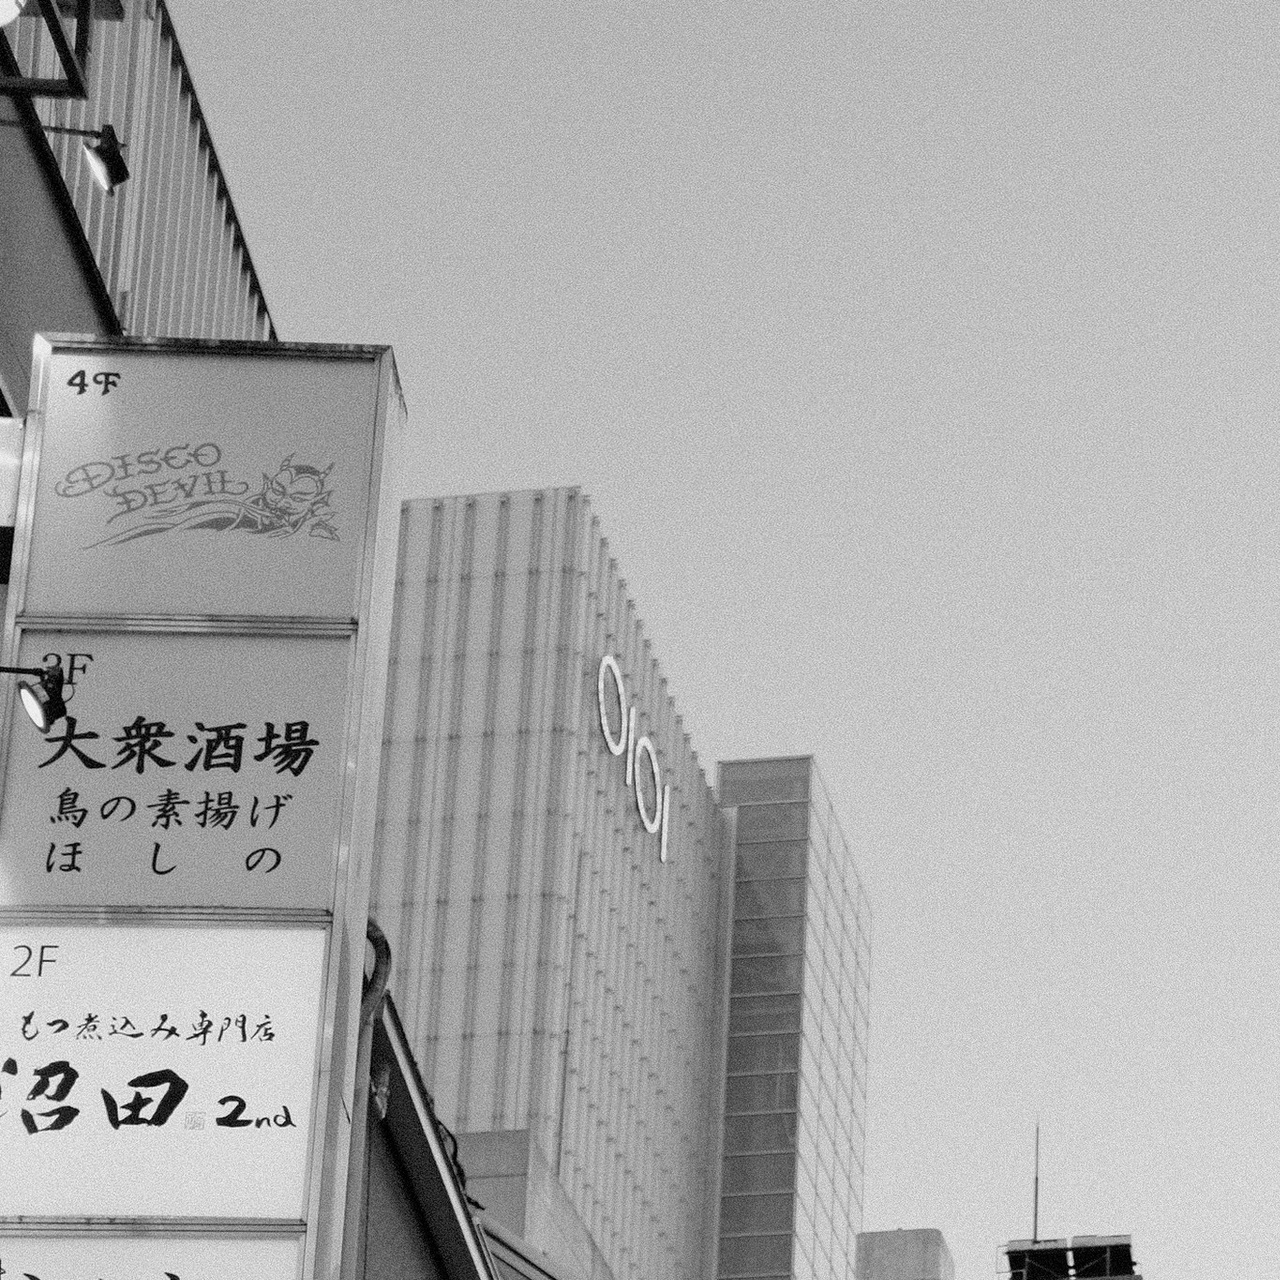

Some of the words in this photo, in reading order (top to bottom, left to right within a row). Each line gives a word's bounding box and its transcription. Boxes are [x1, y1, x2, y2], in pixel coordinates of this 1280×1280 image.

[67, 369, 121, 395] 4F
[55, 442, 222, 499] DISCO
[103, 469, 249, 524] DEVIL
[38, 715, 320, 777] 大衆酒場
[49, 785, 293, 829] 鳥の素揚げ
[10, 943, 60, 978] 2F
[21, 1009, 276, 1043] もつ煮込み専門店
[215, 1094, 297, 1129] 2nd
